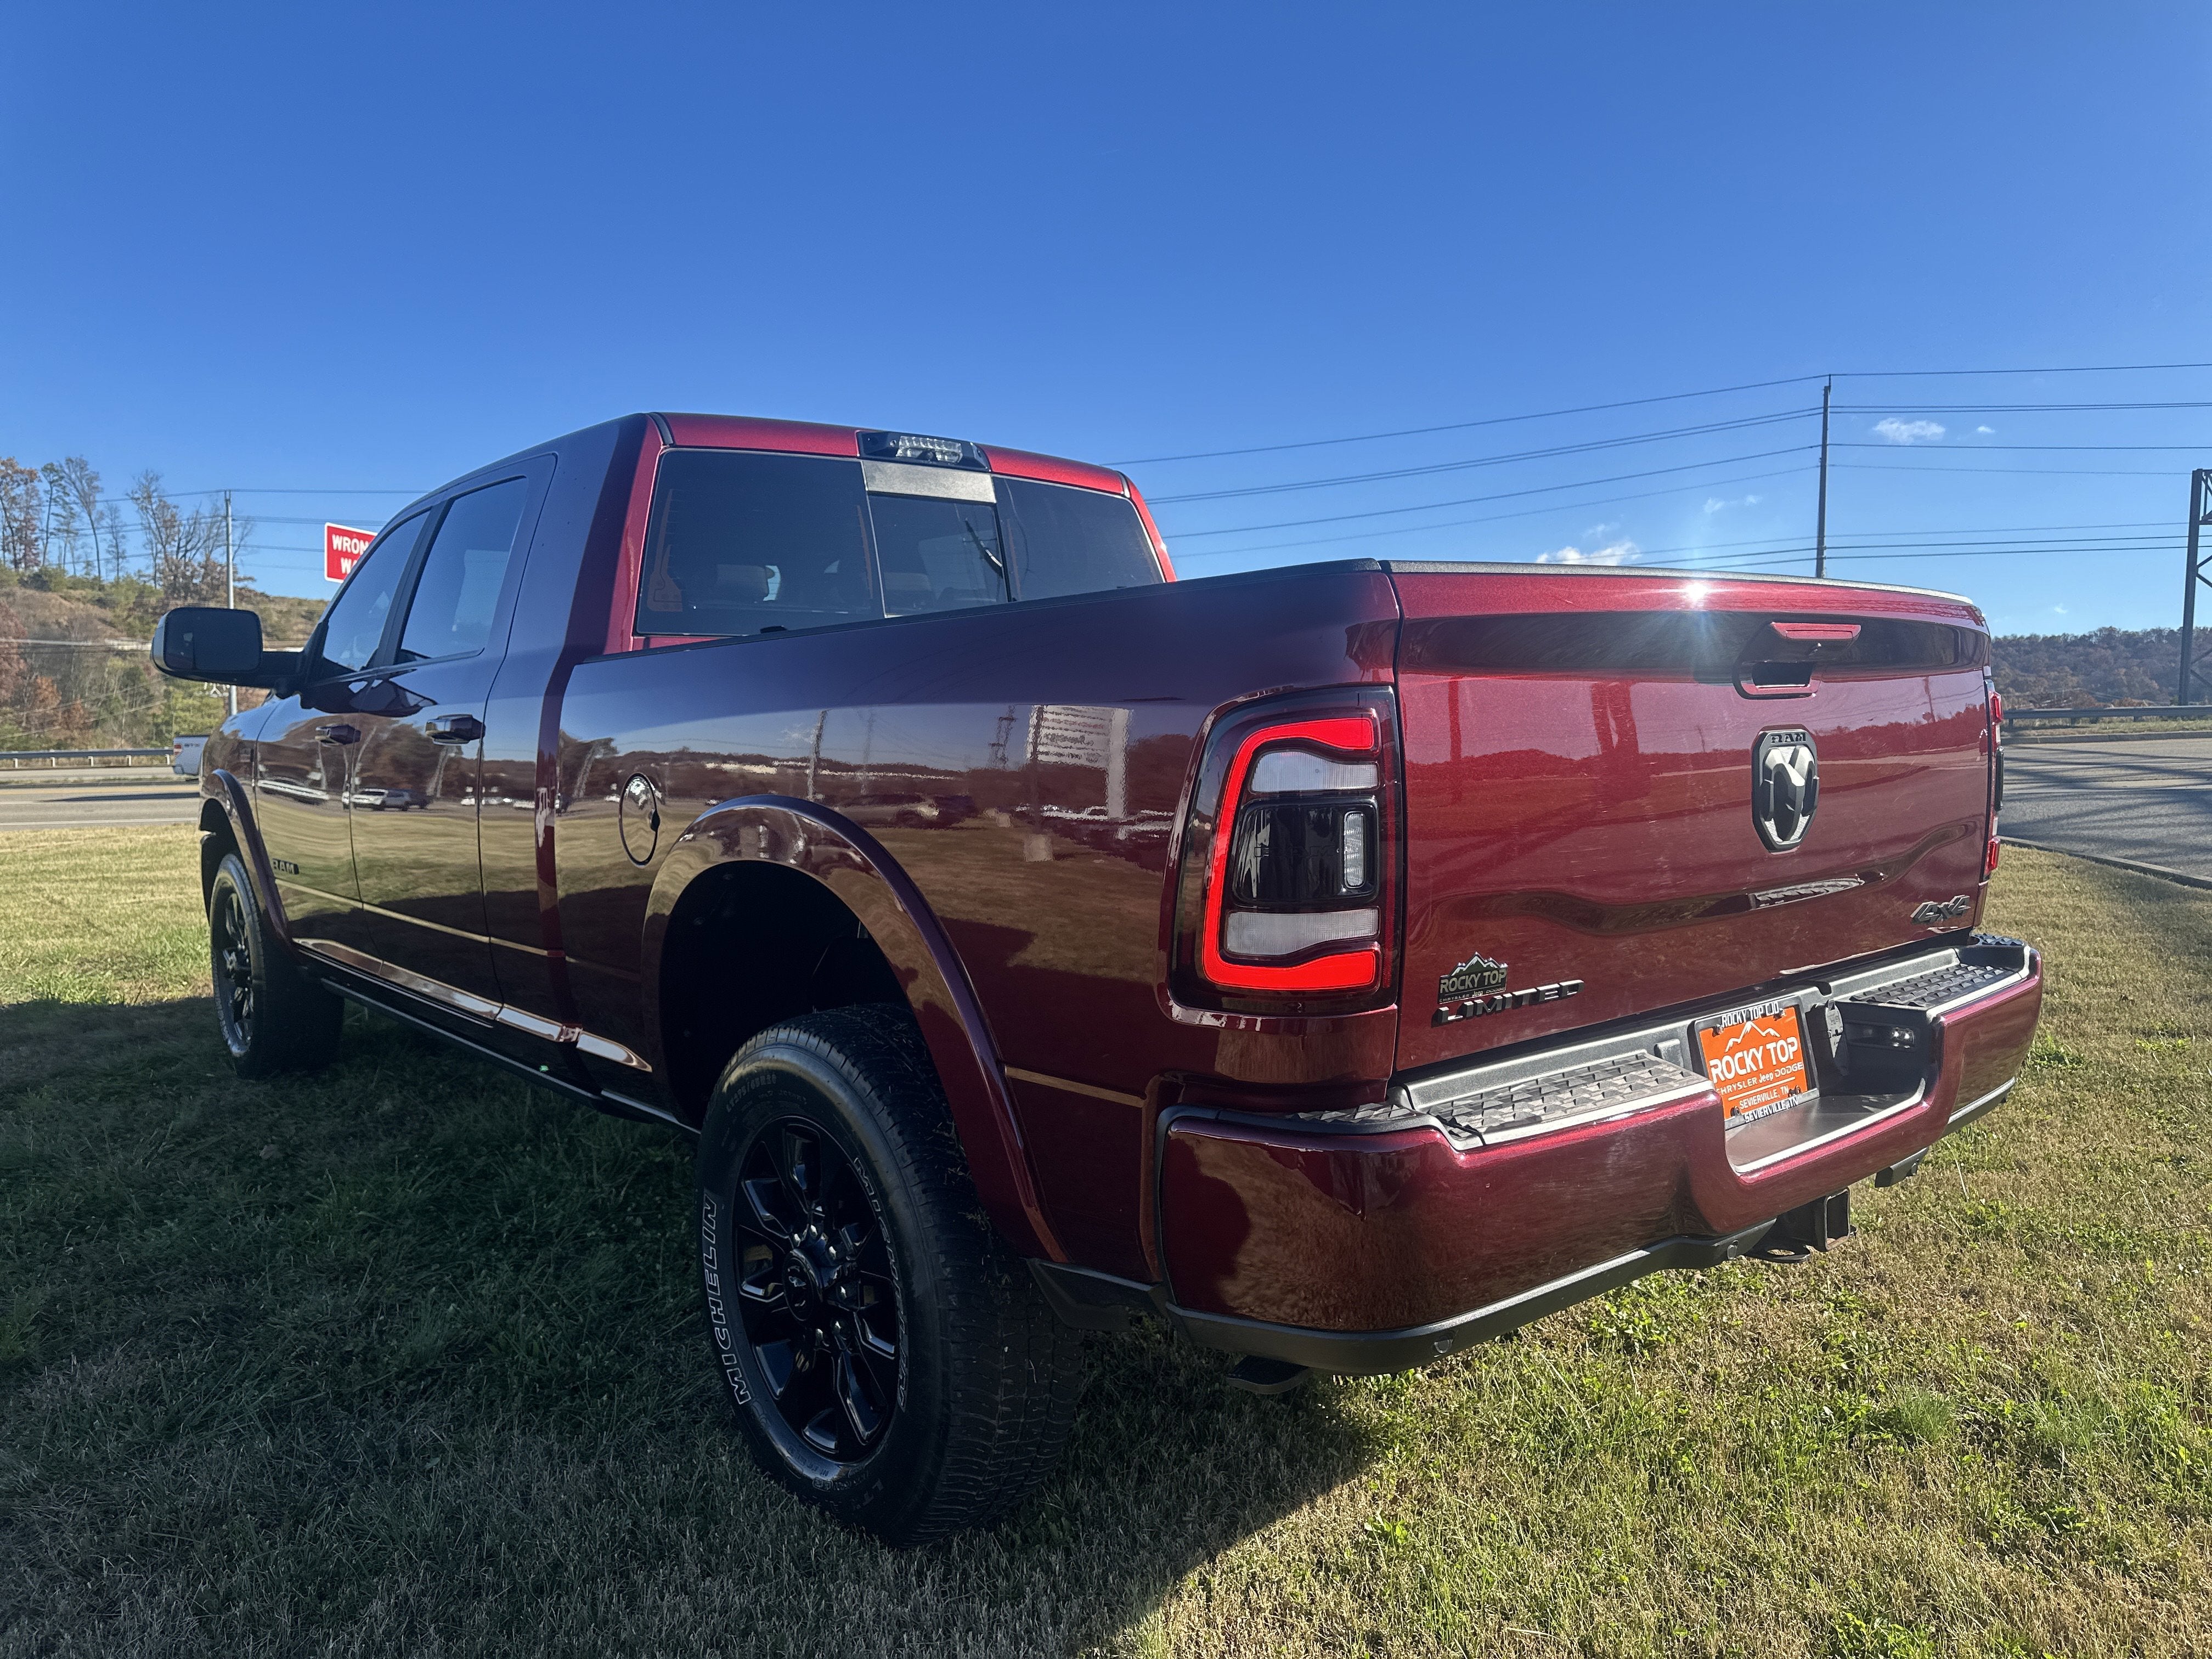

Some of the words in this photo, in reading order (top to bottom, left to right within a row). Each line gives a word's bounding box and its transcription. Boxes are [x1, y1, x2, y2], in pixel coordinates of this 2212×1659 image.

[332, 533, 370, 555] WRON
[1770, 732, 1806, 743] RAM
[273, 858, 299, 874] RAM
[1440, 973, 1481, 994] ROCKY
[1483, 969, 1507, 986] TOP
[1432, 979, 1584, 1027] LIMITED
[1439, 994, 1470, 1002] CHRYSLER
[1722, 1009, 1746, 1028] ROCKY
[1749, 1005, 1763, 1020] TOP
[1765, 1001, 1779, 1016] CJD
[1709, 1045, 1763, 1084] ROCKY
[1765, 1036, 1798, 1066] TOP
[1759, 1072, 1774, 1084] Jeep
[1774, 1062, 1803, 1078] DODGE
[1739, 1089, 1780, 1110] SEVIERVILLE,
[1780, 1085, 1788, 1095] TN
[1789, 1095, 1798, 1107] TN
[703, 1193, 751, 1404] MICHELIN
